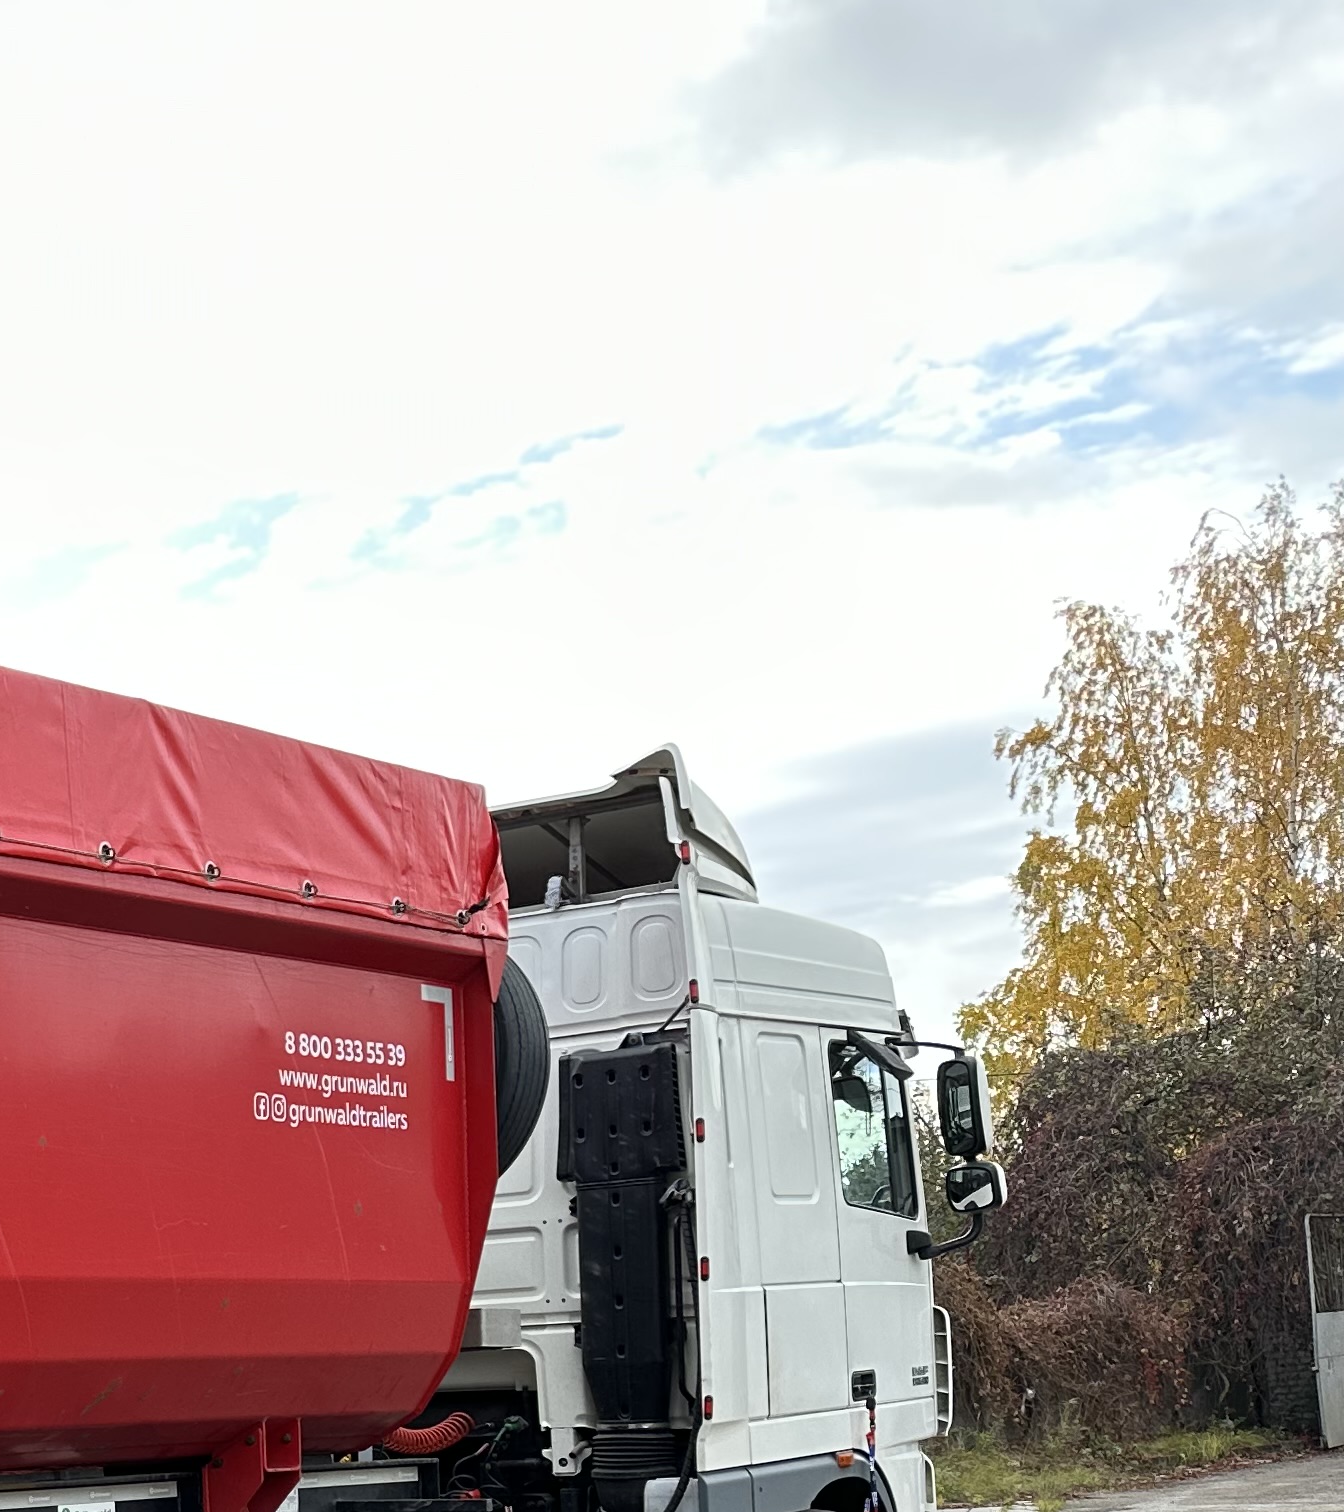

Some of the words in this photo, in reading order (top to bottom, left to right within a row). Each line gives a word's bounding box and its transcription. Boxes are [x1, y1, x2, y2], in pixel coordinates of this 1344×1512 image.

[285, 1031, 296, 1054] 8
[298, 1033, 332, 1059] 800
[335, 1038, 363, 1062] 333
[366, 1042, 385, 1064] 55
[387, 1044, 406, 1067] 39
[279, 1069, 408, 1098] www.grunwald.ru
[289, 1102, 408, 1130] grunwaldtrailers
